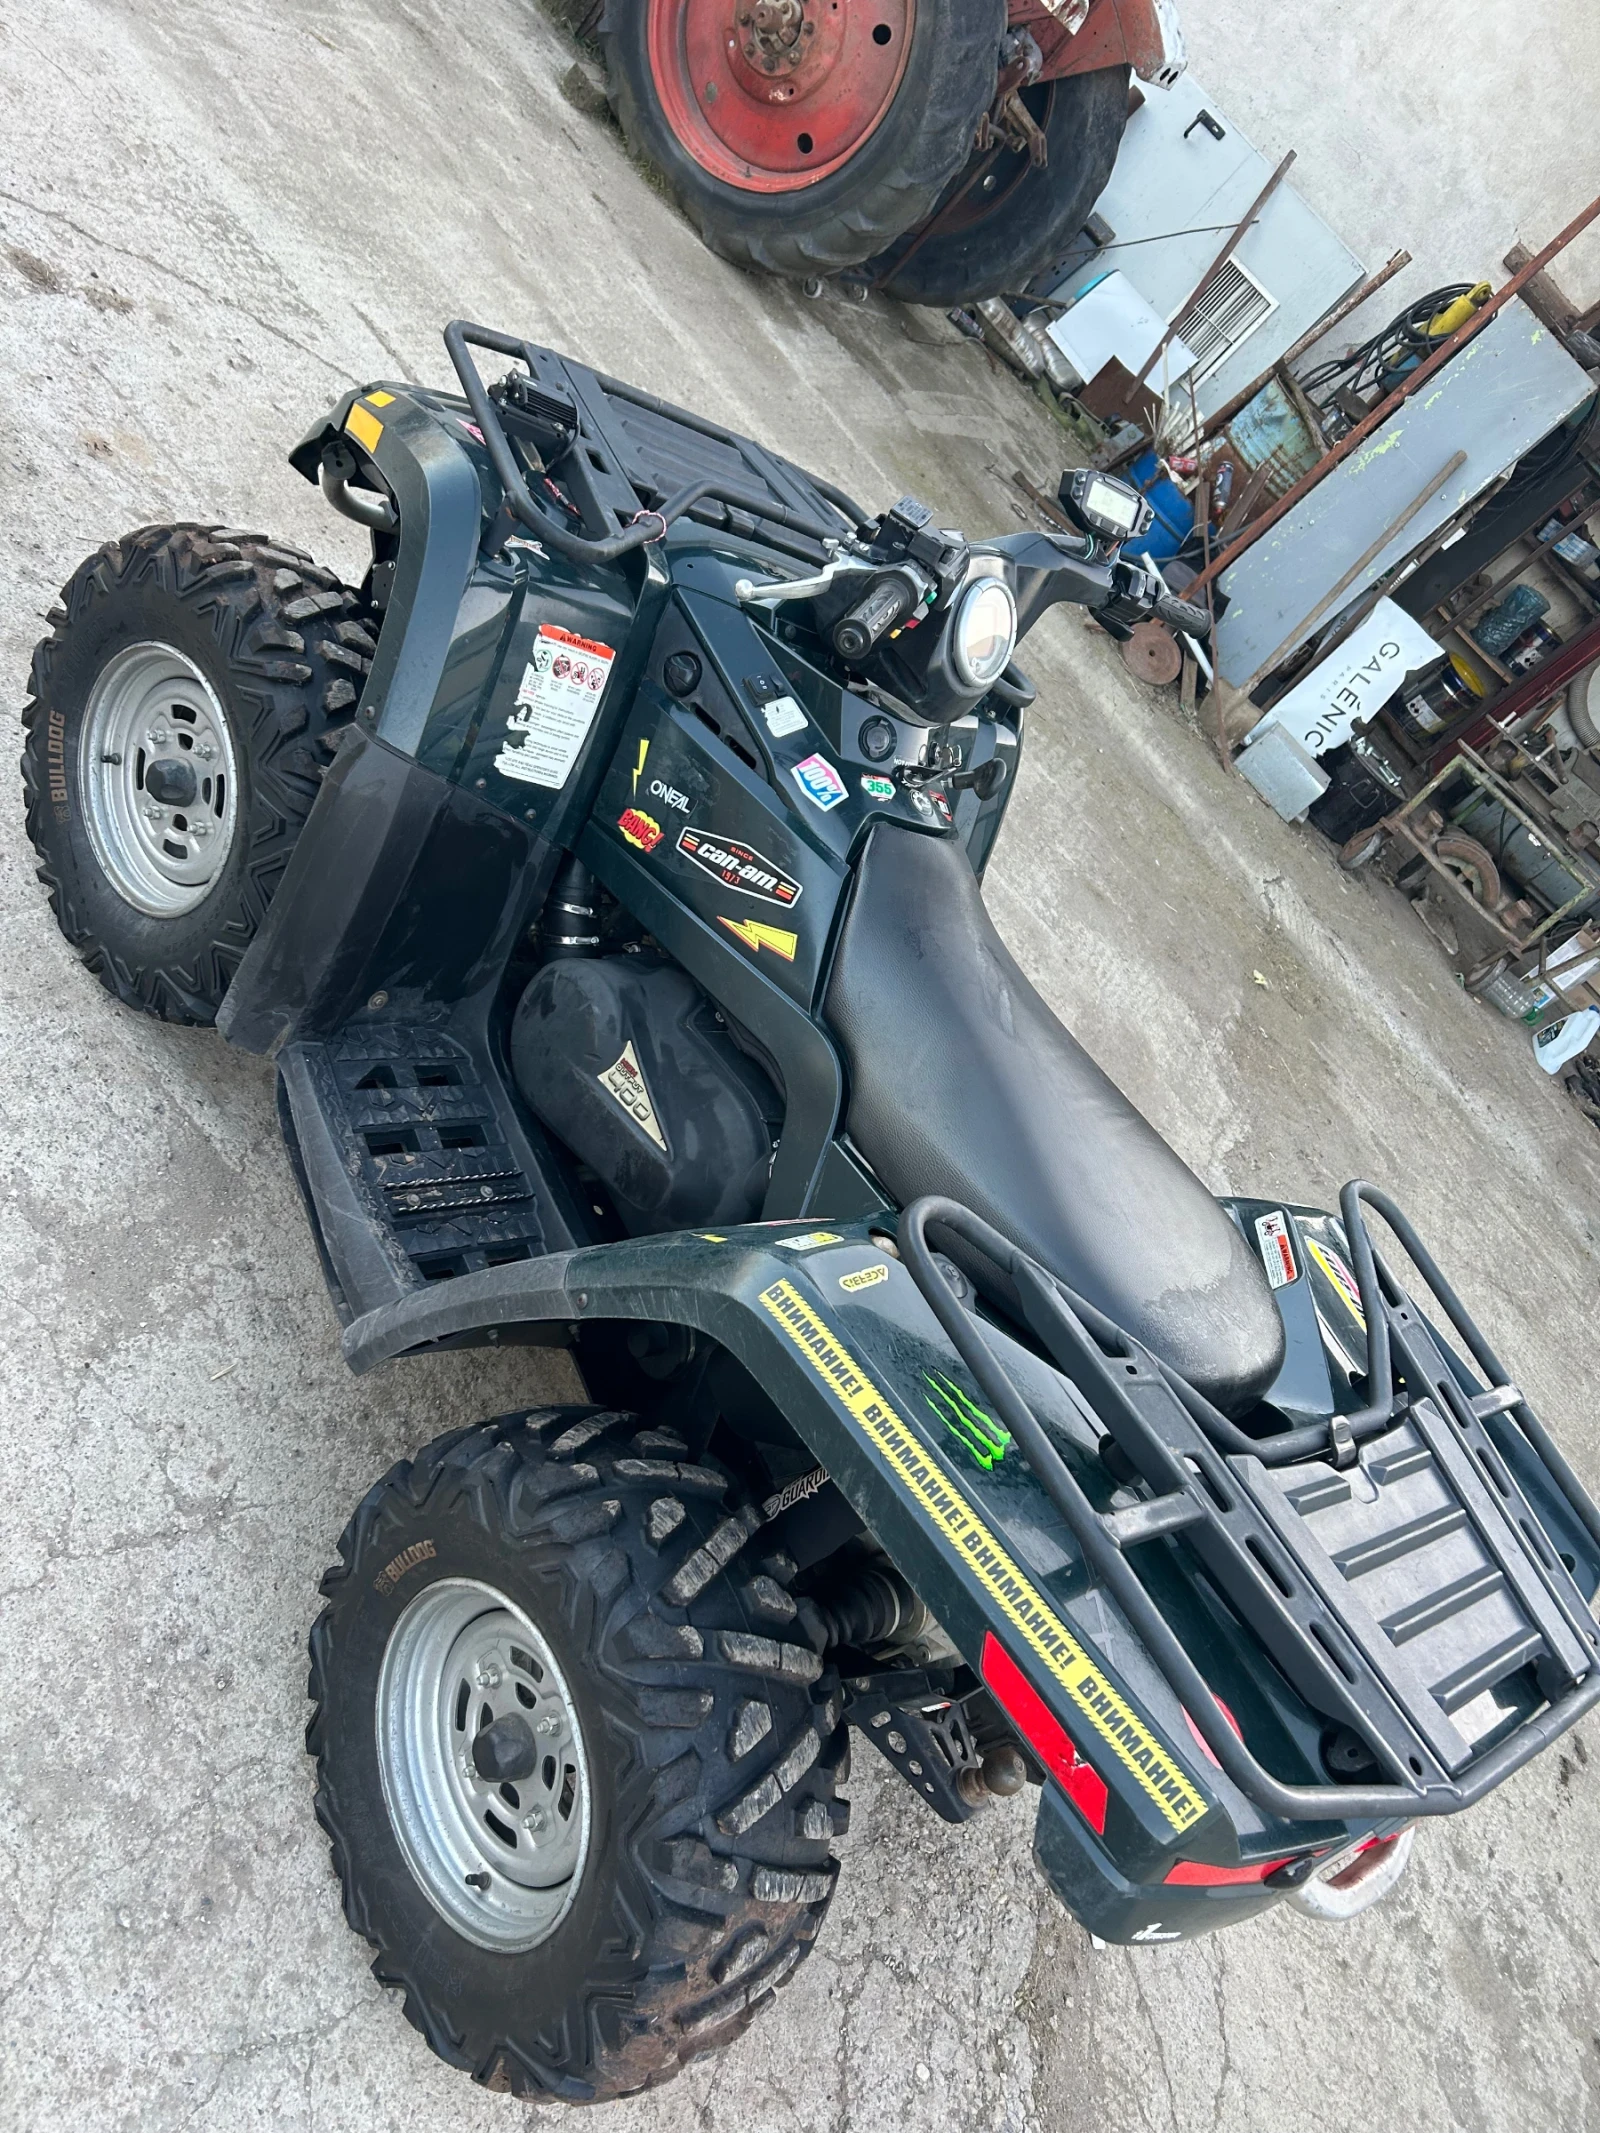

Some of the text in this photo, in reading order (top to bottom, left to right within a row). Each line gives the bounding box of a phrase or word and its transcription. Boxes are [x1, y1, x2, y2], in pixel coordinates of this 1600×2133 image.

[566, 636, 597, 652] WARNING
[1304, 641, 1400, 748] GALÉNIC
[1321, 665, 1351, 700] PARIS
[48, 711, 68, 802] BULLDOG
[798, 761, 842, 802] 100%
[867, 781, 892, 794] 355
[617, 809, 665, 853] BANG!
[730, 846, 753, 862] SINCE
[722, 870, 740, 884] 1973
[608, 1071, 651, 1121] 400
[616, 1063, 644, 1093] OUTPUT
[385, 1539, 437, 1583] BULLDOG
[766, 1284, 864, 1398] ВНИМАНИЕ!
[861, 1404, 965, 1533] ВНИМАНИЕ!
[962, 1529, 1075, 1669] ВНИМАНИЕ!
[1076, 1675, 1201, 1825] ВНИМАНИЕ!
